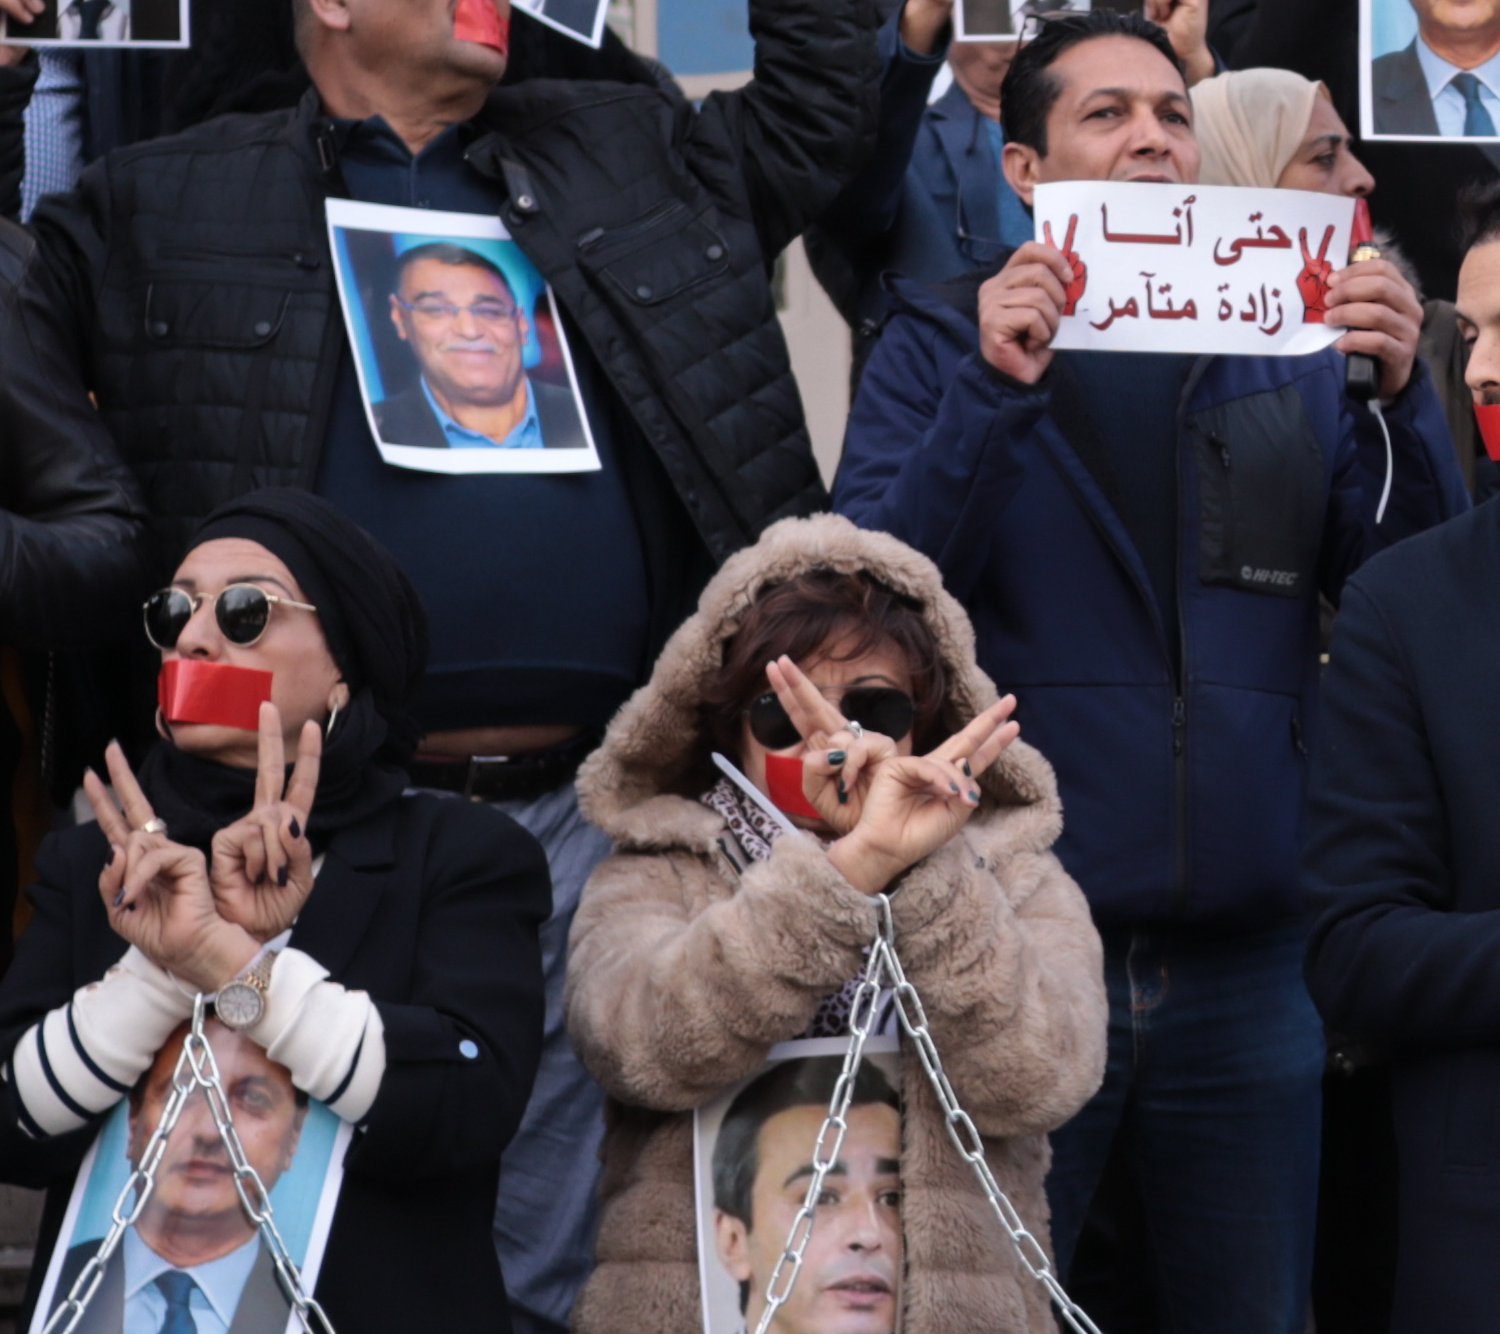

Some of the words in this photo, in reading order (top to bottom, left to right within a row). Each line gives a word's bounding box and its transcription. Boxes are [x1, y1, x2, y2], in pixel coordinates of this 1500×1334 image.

[1212, 210, 1293, 266] حتى
[1090, 271, 1198, 331] متآمر
[1217, 283, 1284, 335] زادة
[1252, 568, 1300, 585] HI-TEC
